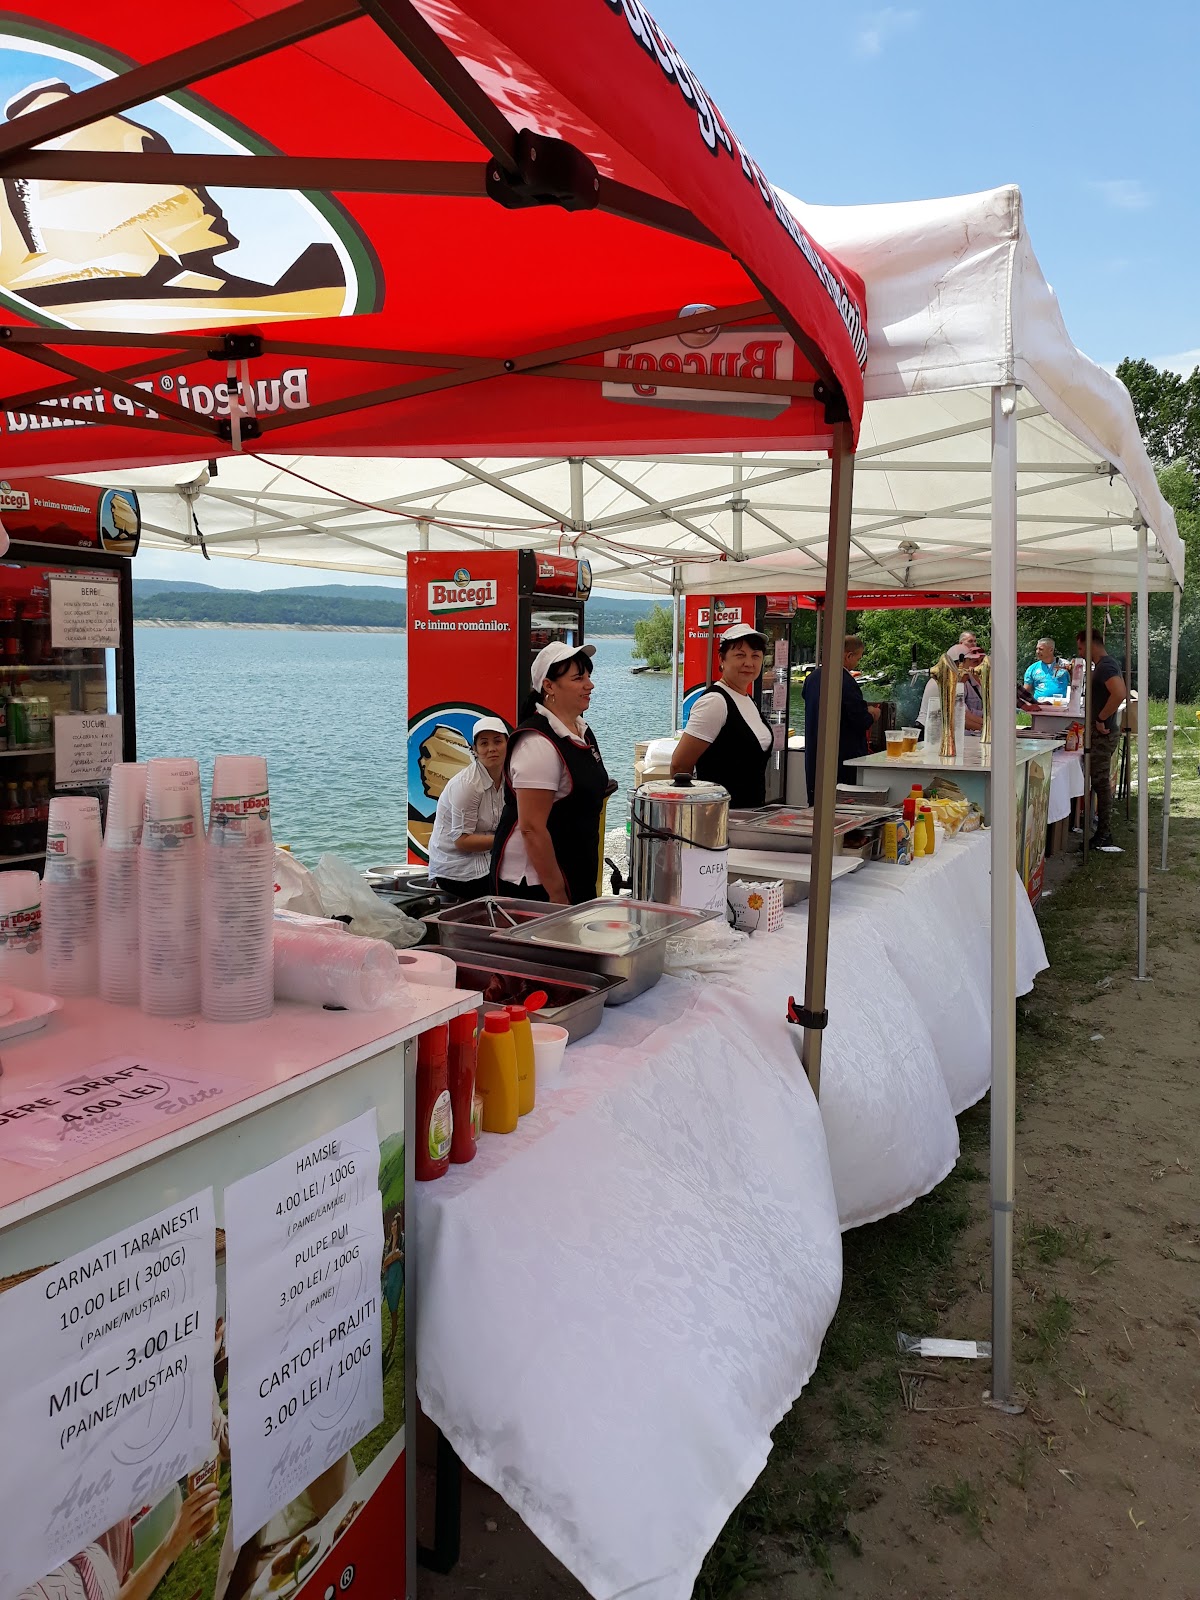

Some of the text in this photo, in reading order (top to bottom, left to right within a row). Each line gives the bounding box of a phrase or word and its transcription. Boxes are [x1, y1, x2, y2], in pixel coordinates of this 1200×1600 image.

[33, 498, 42, 507] Pe
[42, 498, 60, 509] inima
[81, 588, 98, 596] BERE
[432, 582, 492, 606] Bucegi
[414, 619, 511, 632] Pe inima românilor.
[82, 720, 107, 729] SUCURI
[699, 863, 724, 876] CAFEA
[64, 1064, 149, 1096] DRAFT
[61, 1084, 164, 1123] 4.00 LEI
[296, 1140, 338, 1175] HAMSIE
[275, 1192, 301, 1216] 4.00
[303, 1181, 319, 1202] LEI
[329, 1160, 356, 1187] 100G
[45, 1206, 199, 1300] CARNATI TARANESTI
[295, 1223, 349, 1268] PULPE PUI
[280, 1281, 304, 1308] 3.00
[307, 1268, 322, 1289] LEI
[333, 1245, 360, 1273] 100G
[60, 1293, 105, 1331] 10.00
[109, 1277, 130, 1303] LEI
[49, 1369, 99, 1418] MICI
[125, 1329, 168, 1371] 3.00
[174, 1310, 199, 1342] LEI
[259, 1297, 376, 1399] CARTOFI PRAJITI
[60, 1354, 188, 1450] (PAINE/MUSTAR)
[264, 1397, 298, 1437] 3.00
[302, 1377, 322, 1407] LEI
[338, 1338, 371, 1379] 100G
